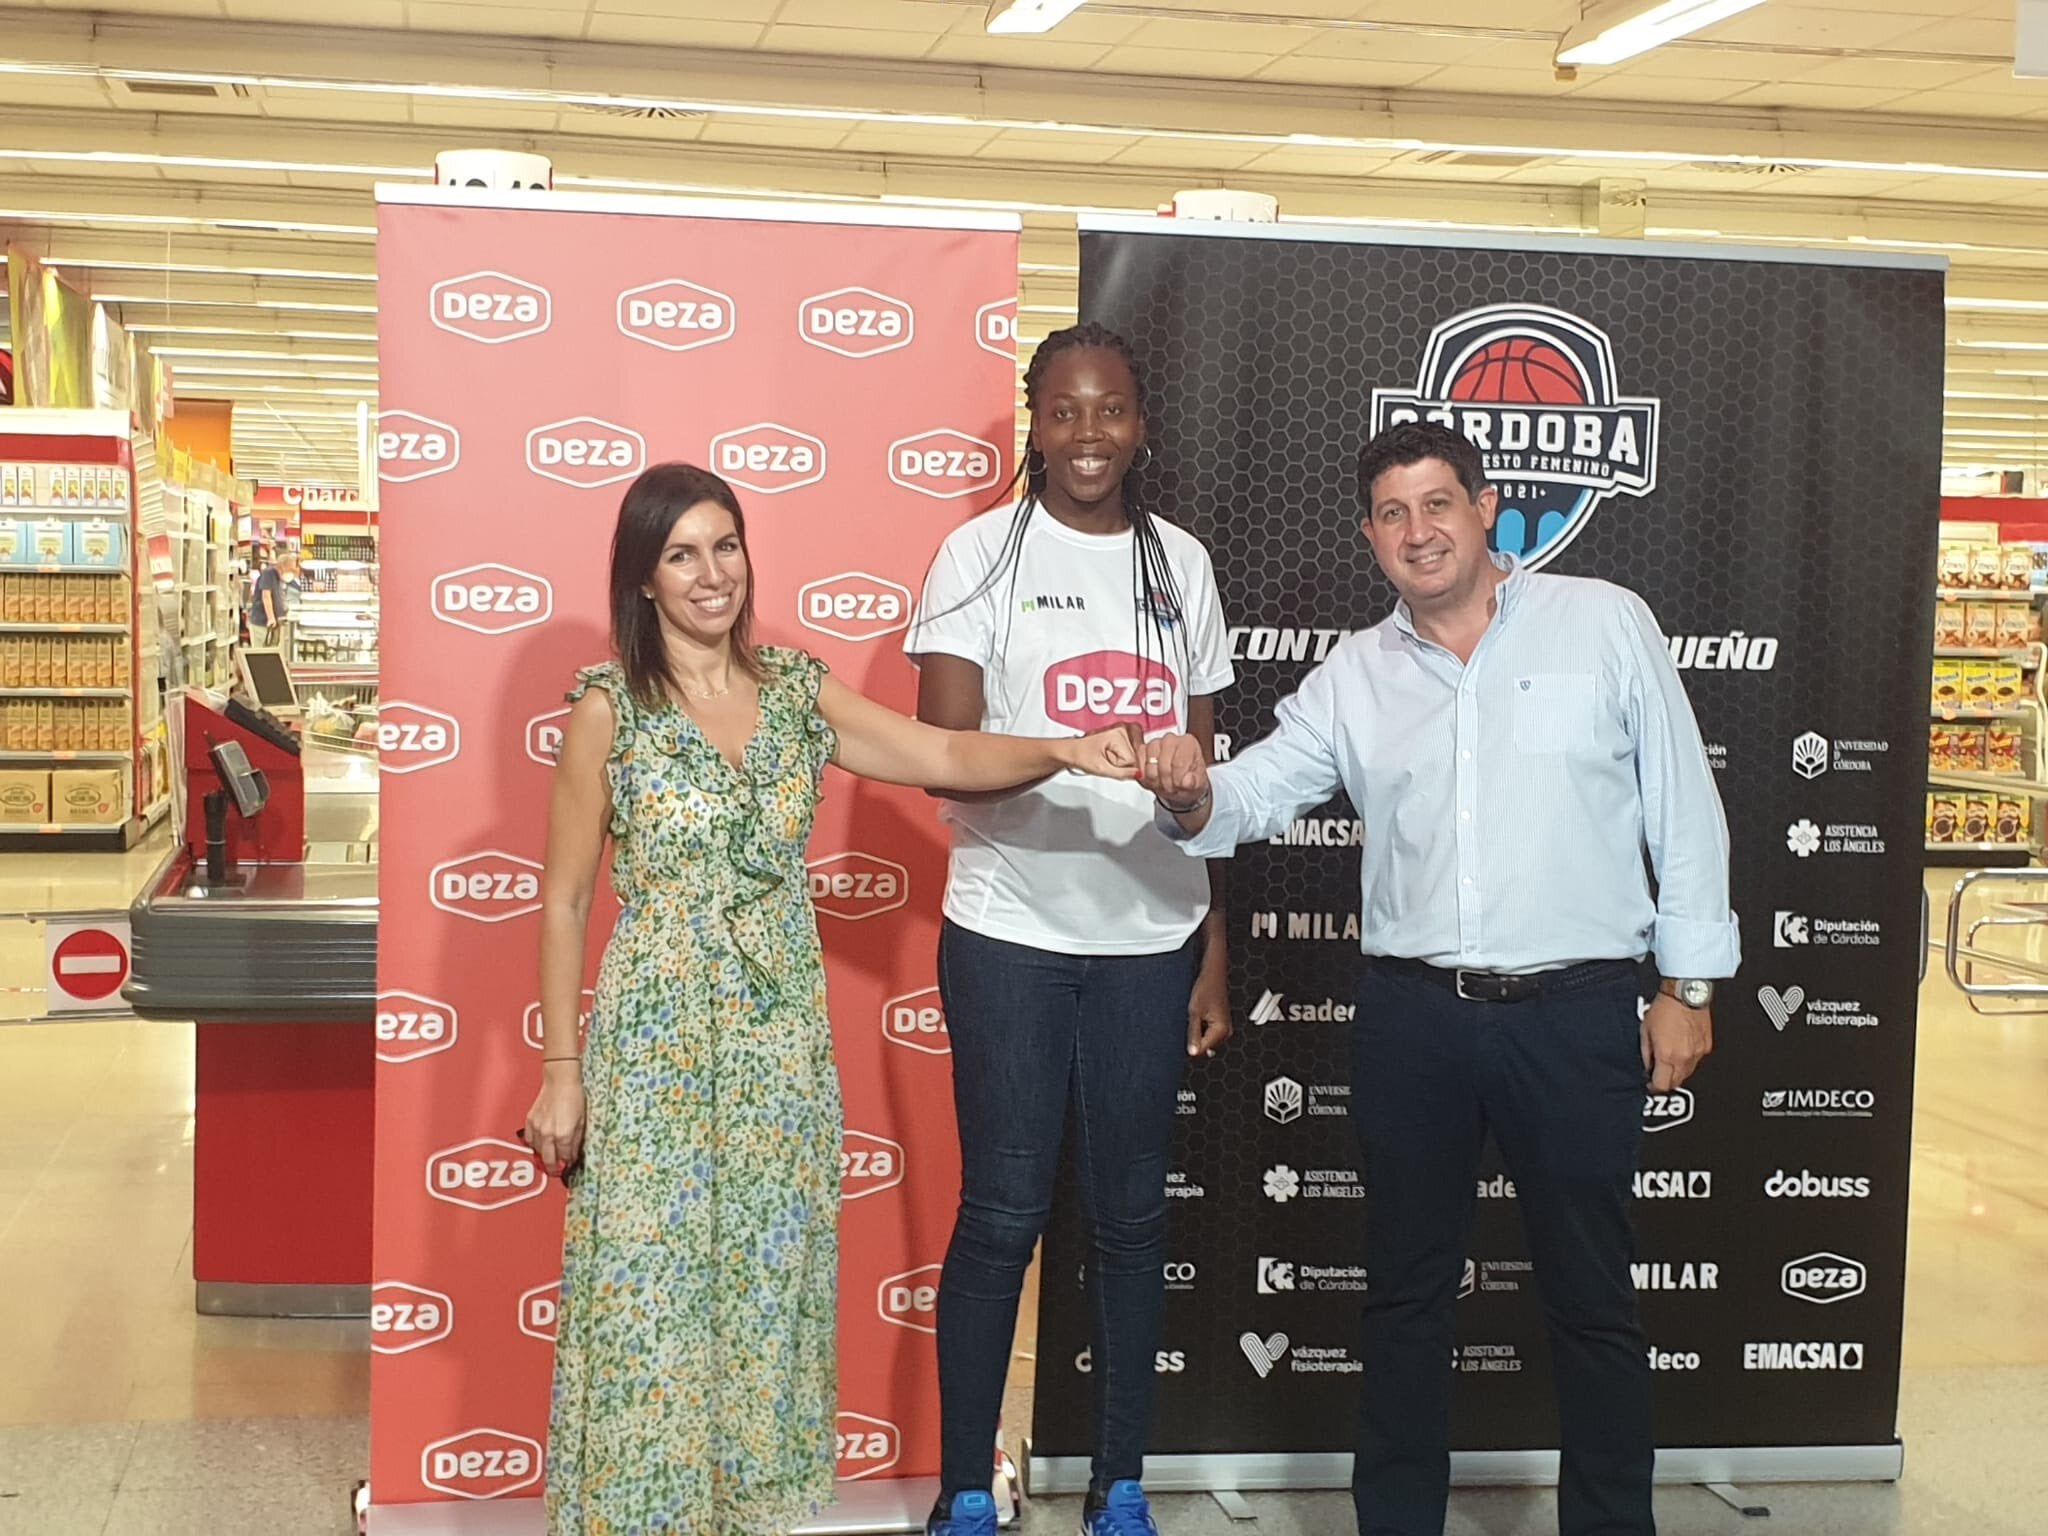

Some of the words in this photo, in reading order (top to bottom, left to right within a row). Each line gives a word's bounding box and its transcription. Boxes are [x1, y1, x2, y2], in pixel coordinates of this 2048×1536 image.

[443, 292, 538, 322] Deza
[629, 300, 722, 329] Deza
[811, 308, 901, 336] Deza
[378, 432, 446, 460] eza
[538, 438, 633, 467] Deza
[722, 444, 813, 472] Deza
[900, 450, 989, 478] Deza
[1531, 455, 1610, 477] FEMENINO
[444, 585, 540, 613] Deza
[811, 593, 900, 620] Deza
[1037, 596, 1086, 610] MILAR
[1663, 630, 1778, 670] UEÑO
[1056, 674, 1174, 716] Deza
[378, 724, 446, 751] eza
[1834, 740, 1889, 752] UNIVERSIDAD
[1825, 825, 1878, 837] ASISTENCIA
[1824, 840, 1841, 853] LOS
[443, 873, 538, 900] Deza
[1288, 912, 1360, 940] MILA
[1813, 934, 1828, 944] de
[1830, 933, 1880, 945] Córdoba
[1814, 919, 1880, 934] Diputación
[1806, 1000, 1860, 1014] vázquez
[1806, 1013, 1879, 1027] fisioterapia
[375, 1012, 444, 1040] eza
[1788, 1090, 1875, 1108] IMDECO
[439, 1160, 535, 1188] Deza
[1304, 1170, 1358, 1182] ASISTENCIA
[1764, 1169, 1870, 1198] dobuss
[1303, 1185, 1321, 1197] LOS
[1300, 1279, 1315, 1289] de
[1318, 1279, 1367, 1290] Córdoba
[1301, 1265, 1367, 1280] Diputación
[1789, 1267, 1858, 1289] Deza
[371, 1303, 440, 1331] eza
[1291, 1360, 1363, 1373] fisioterapia
[1292, 1348, 1347, 1361] vázquez
[1743, 1343, 1837, 1370] EMACSA
[435, 1449, 530, 1480] Deza
